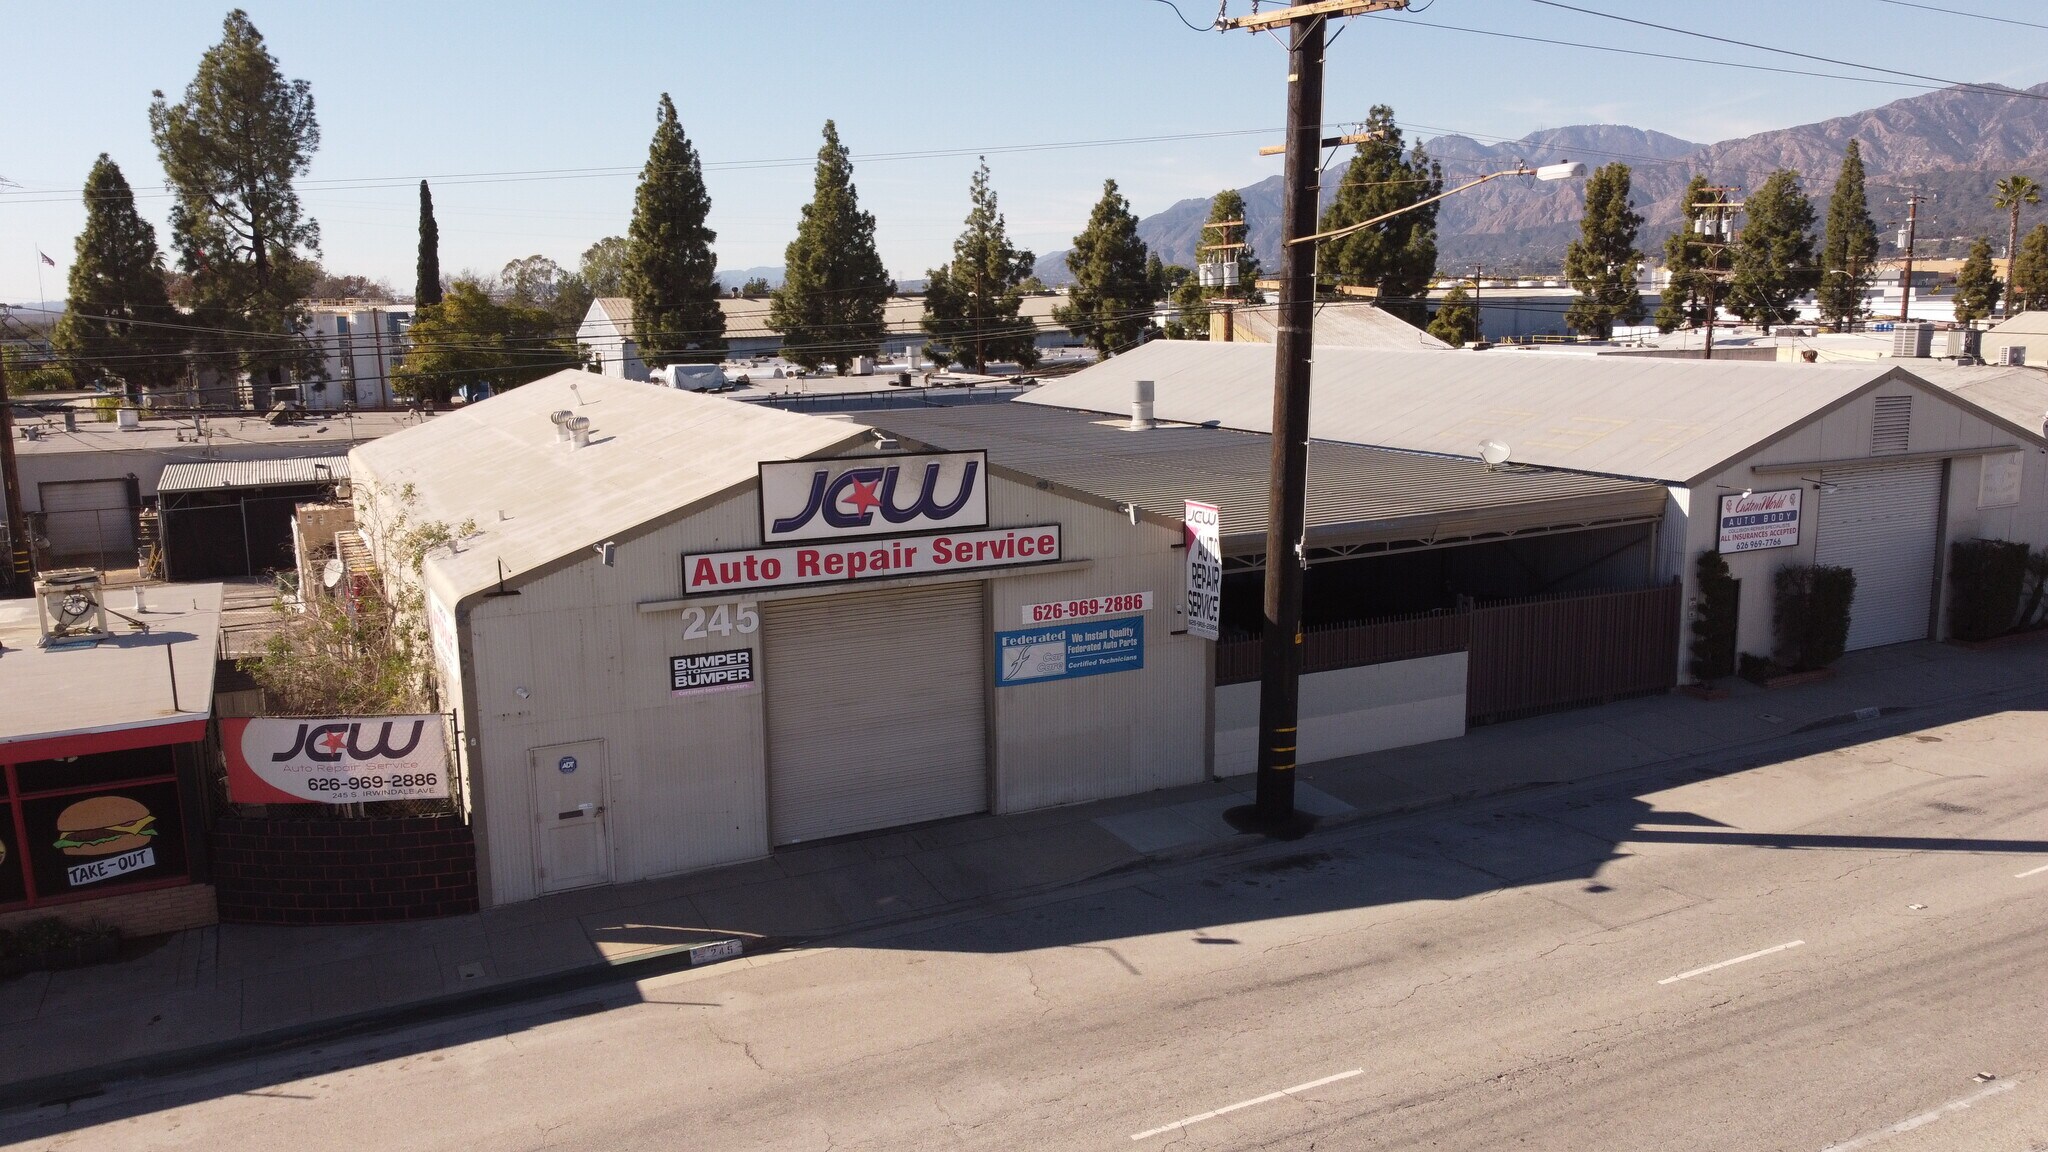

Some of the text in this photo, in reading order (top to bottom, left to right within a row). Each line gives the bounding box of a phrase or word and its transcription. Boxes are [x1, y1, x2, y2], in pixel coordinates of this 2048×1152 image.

[771, 461, 979, 533] JCW
[1729, 512, 1791, 526] AUTO BODY
[1732, 531, 1768, 541] INSURANCES
[1769, 527, 1797, 537] ACCEPTED
[1197, 535, 1220, 564] AUTO
[1736, 538, 1781, 550] 626 969-7766
[692, 533, 1055, 586] Auto Repair Service
[1191, 563, 1220, 593] REPAIR
[1032, 594, 1143, 622] 626-969-2886
[1188, 590, 1219, 622] SERVICE
[681, 602, 759, 640] 245
[1002, 631, 1066, 647] Federated
[1071, 627, 1134, 643] We Install Quality
[1067, 638, 1138, 654] Federated Auto Parts
[673, 652, 749, 670] BUMPER
[1042, 652, 1064, 662] Car
[1068, 655, 1138, 669] Certified Technicians
[1037, 662, 1064, 672] Care
[675, 669, 750, 688] BUMPER
[271, 720, 425, 762] JCW
[283, 761, 419, 774] Auto Repair Service
[561, 761, 575, 769] ADT
[308, 773, 438, 791] 626-969-2886
[362, 788, 415, 797] IRWINDALE
[69, 851, 146, 884] TAKE-OUT
